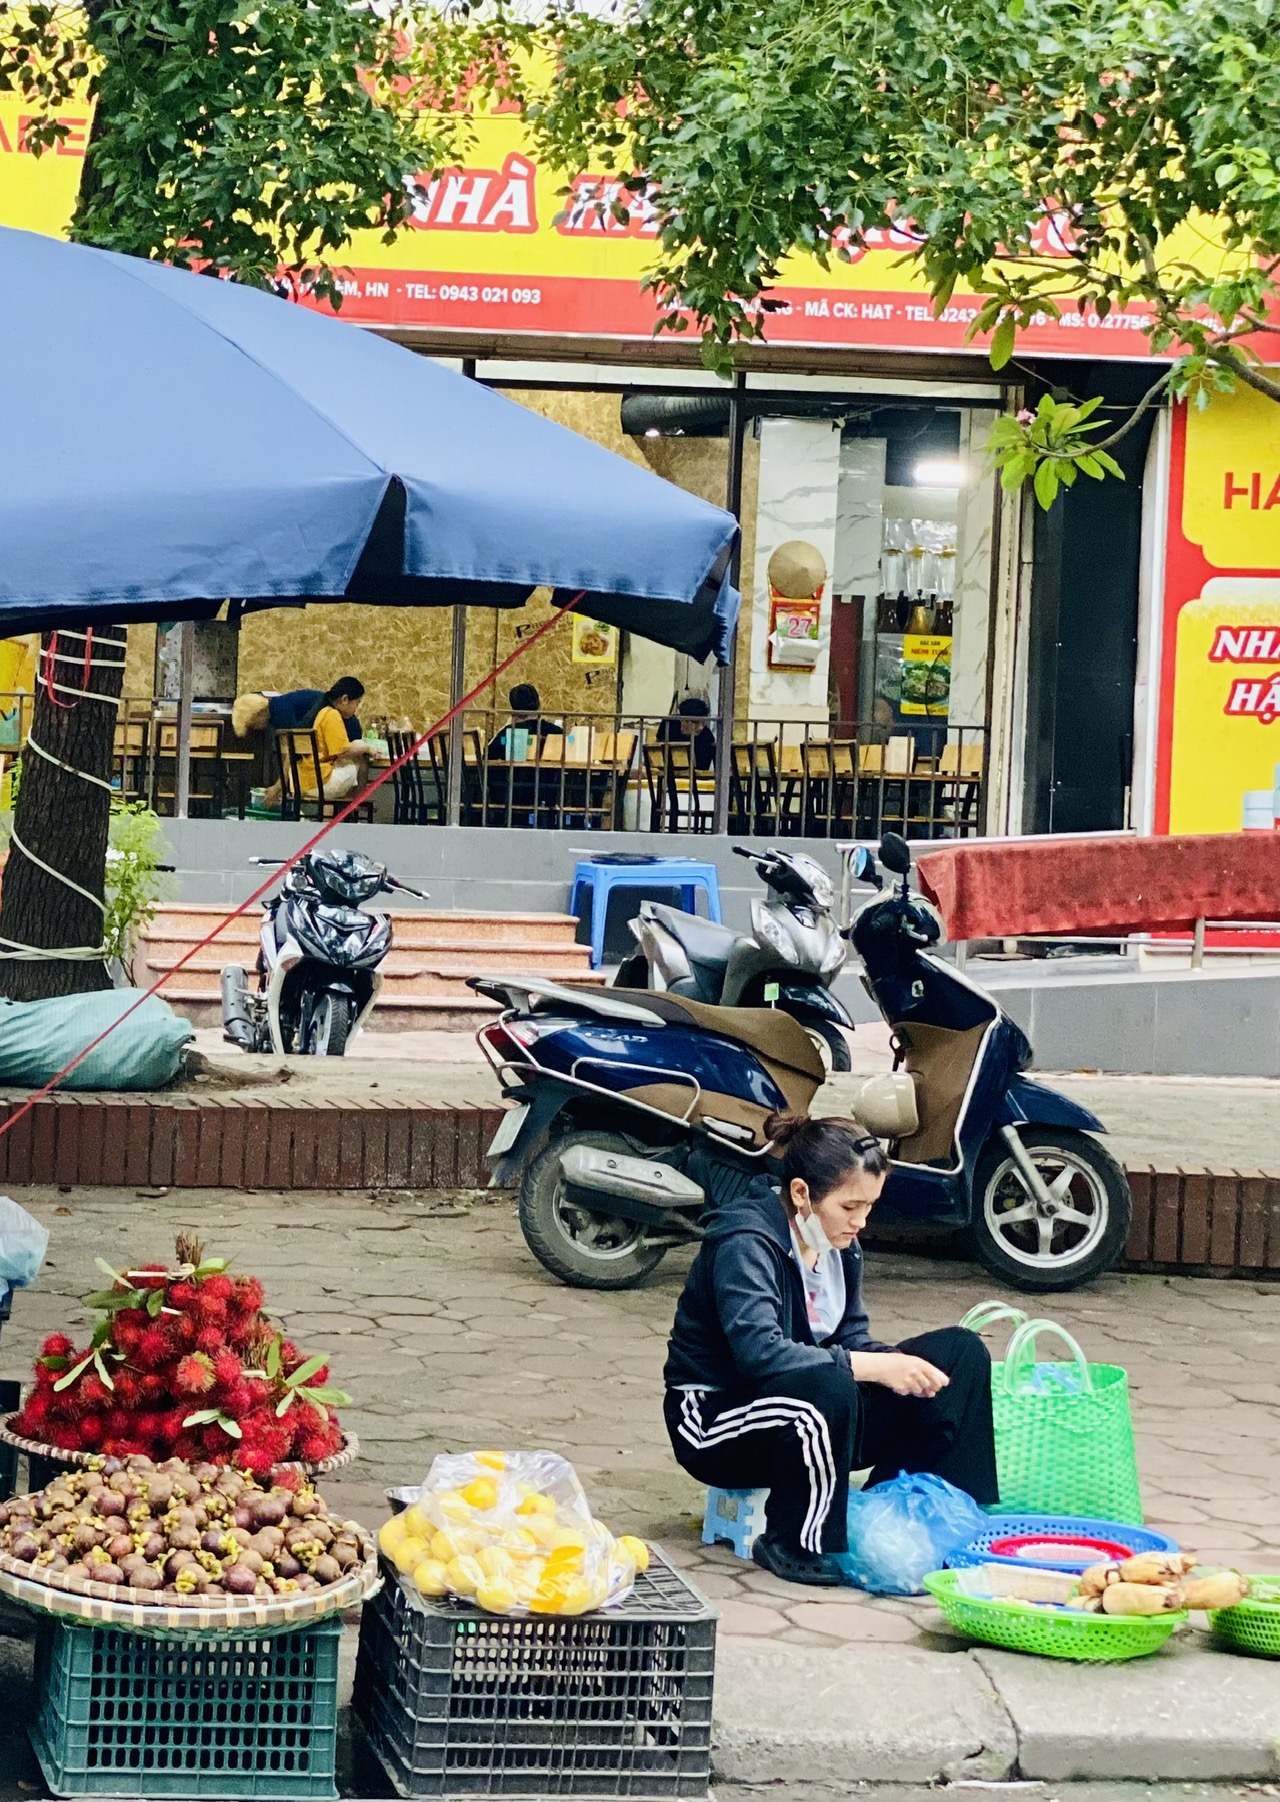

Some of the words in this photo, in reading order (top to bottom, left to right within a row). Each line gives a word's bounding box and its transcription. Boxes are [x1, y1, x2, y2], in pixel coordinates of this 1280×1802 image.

[365, 281, 390, 297] HN
[405, 283, 436, 300] TEL:
[439, 285, 479, 302] 0943
[481, 287, 509, 303] 021
[511, 288, 542, 304] 093
[805, 298, 830, 318] MÃ
[833, 303, 858, 319] CK:
[861, 304, 893, 320] HAT
[787, 617, 813, 638] 27
